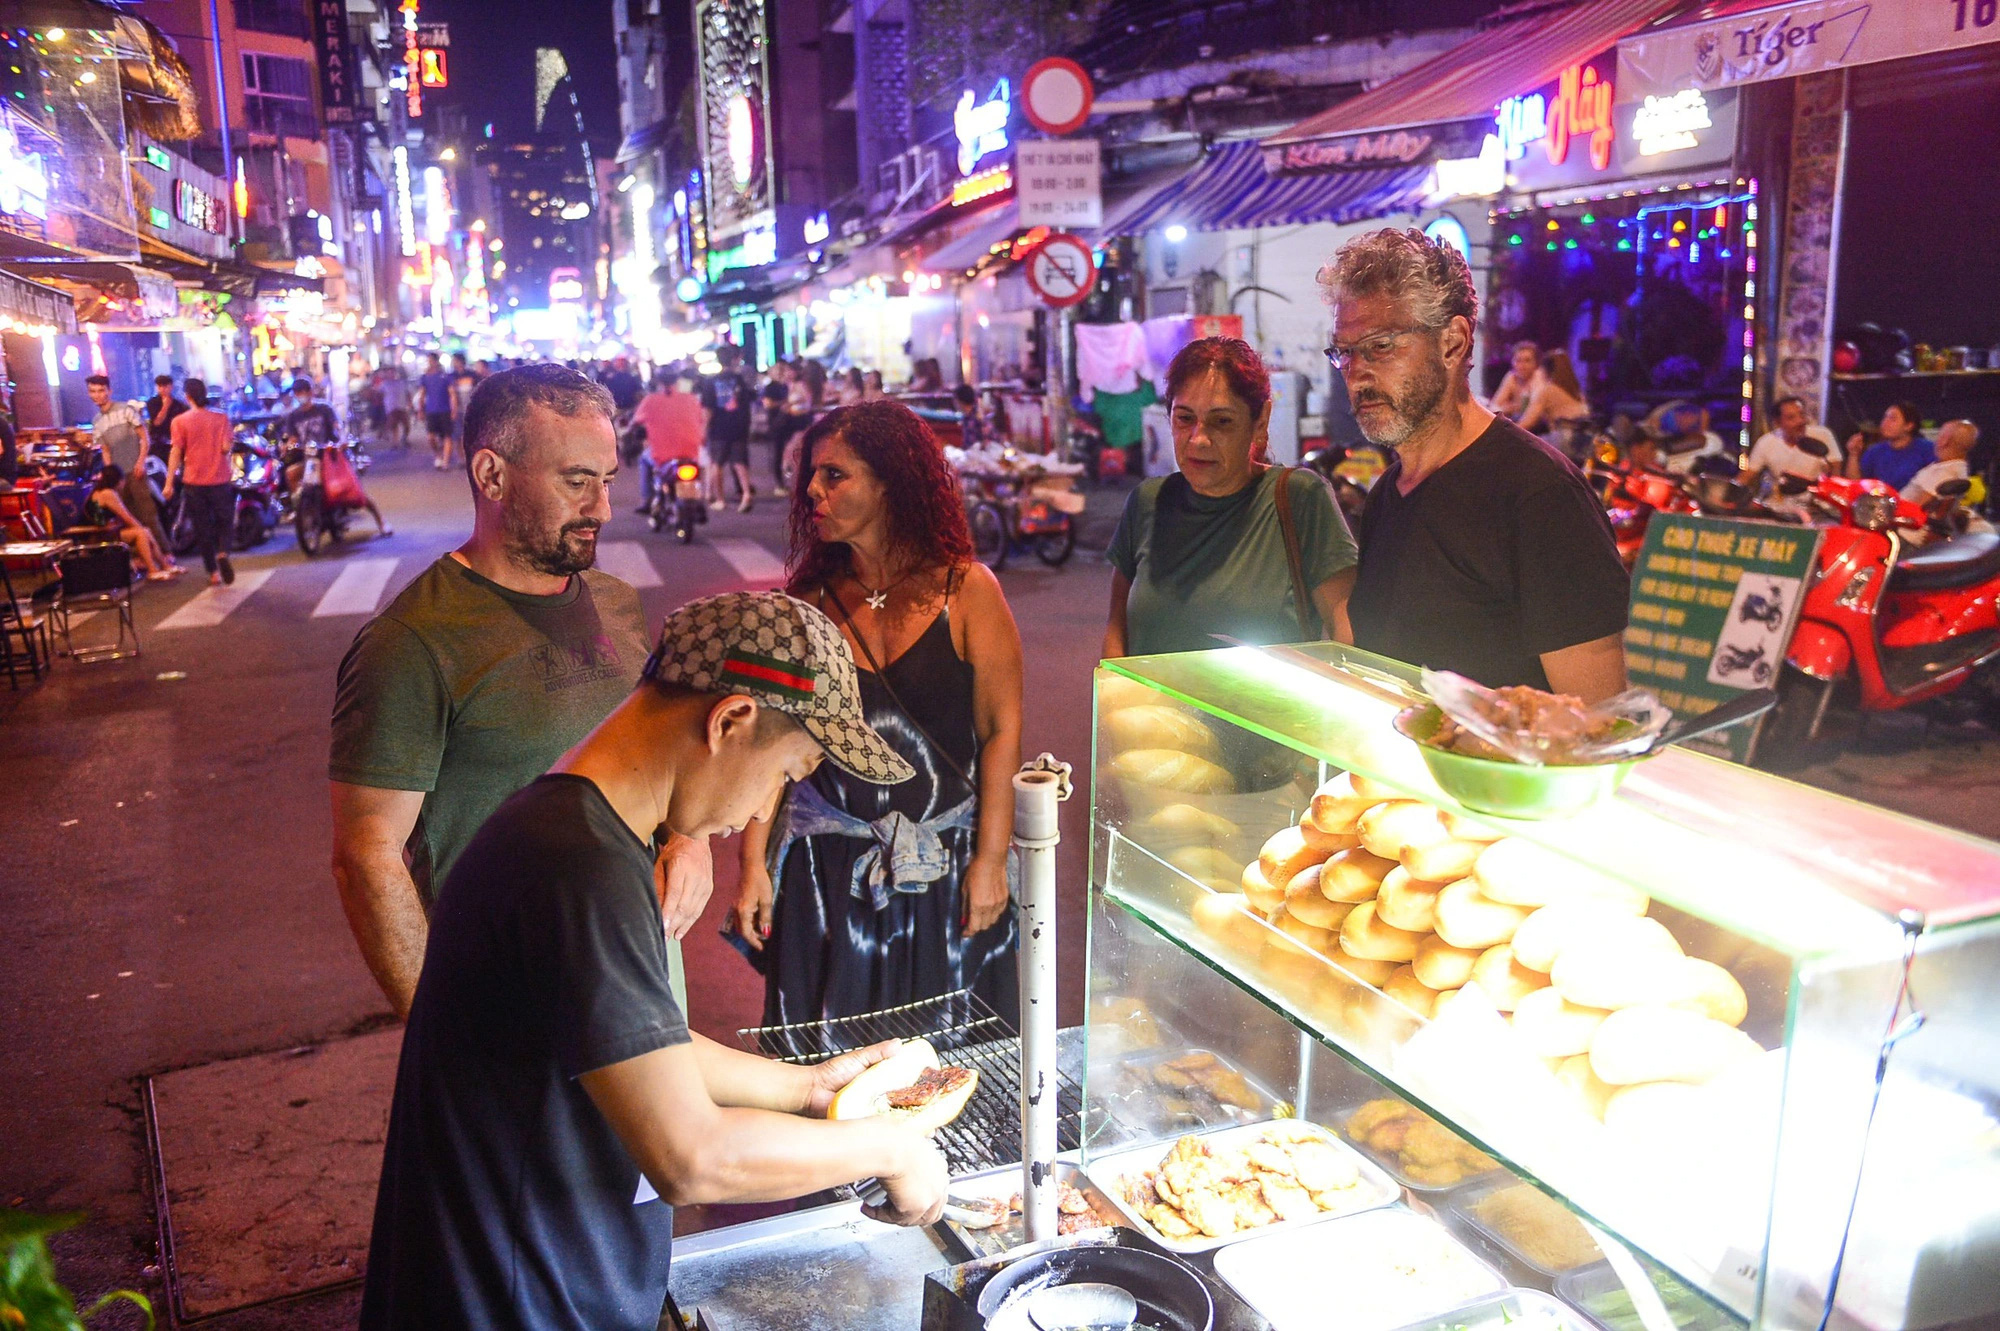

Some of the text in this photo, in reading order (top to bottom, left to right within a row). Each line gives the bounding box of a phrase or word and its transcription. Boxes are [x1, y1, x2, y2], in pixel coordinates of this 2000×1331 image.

[321, 3, 342, 102] MERAKI
[1733, 13, 1825, 65] Tiger
[590, 669, 598, 683] IS
